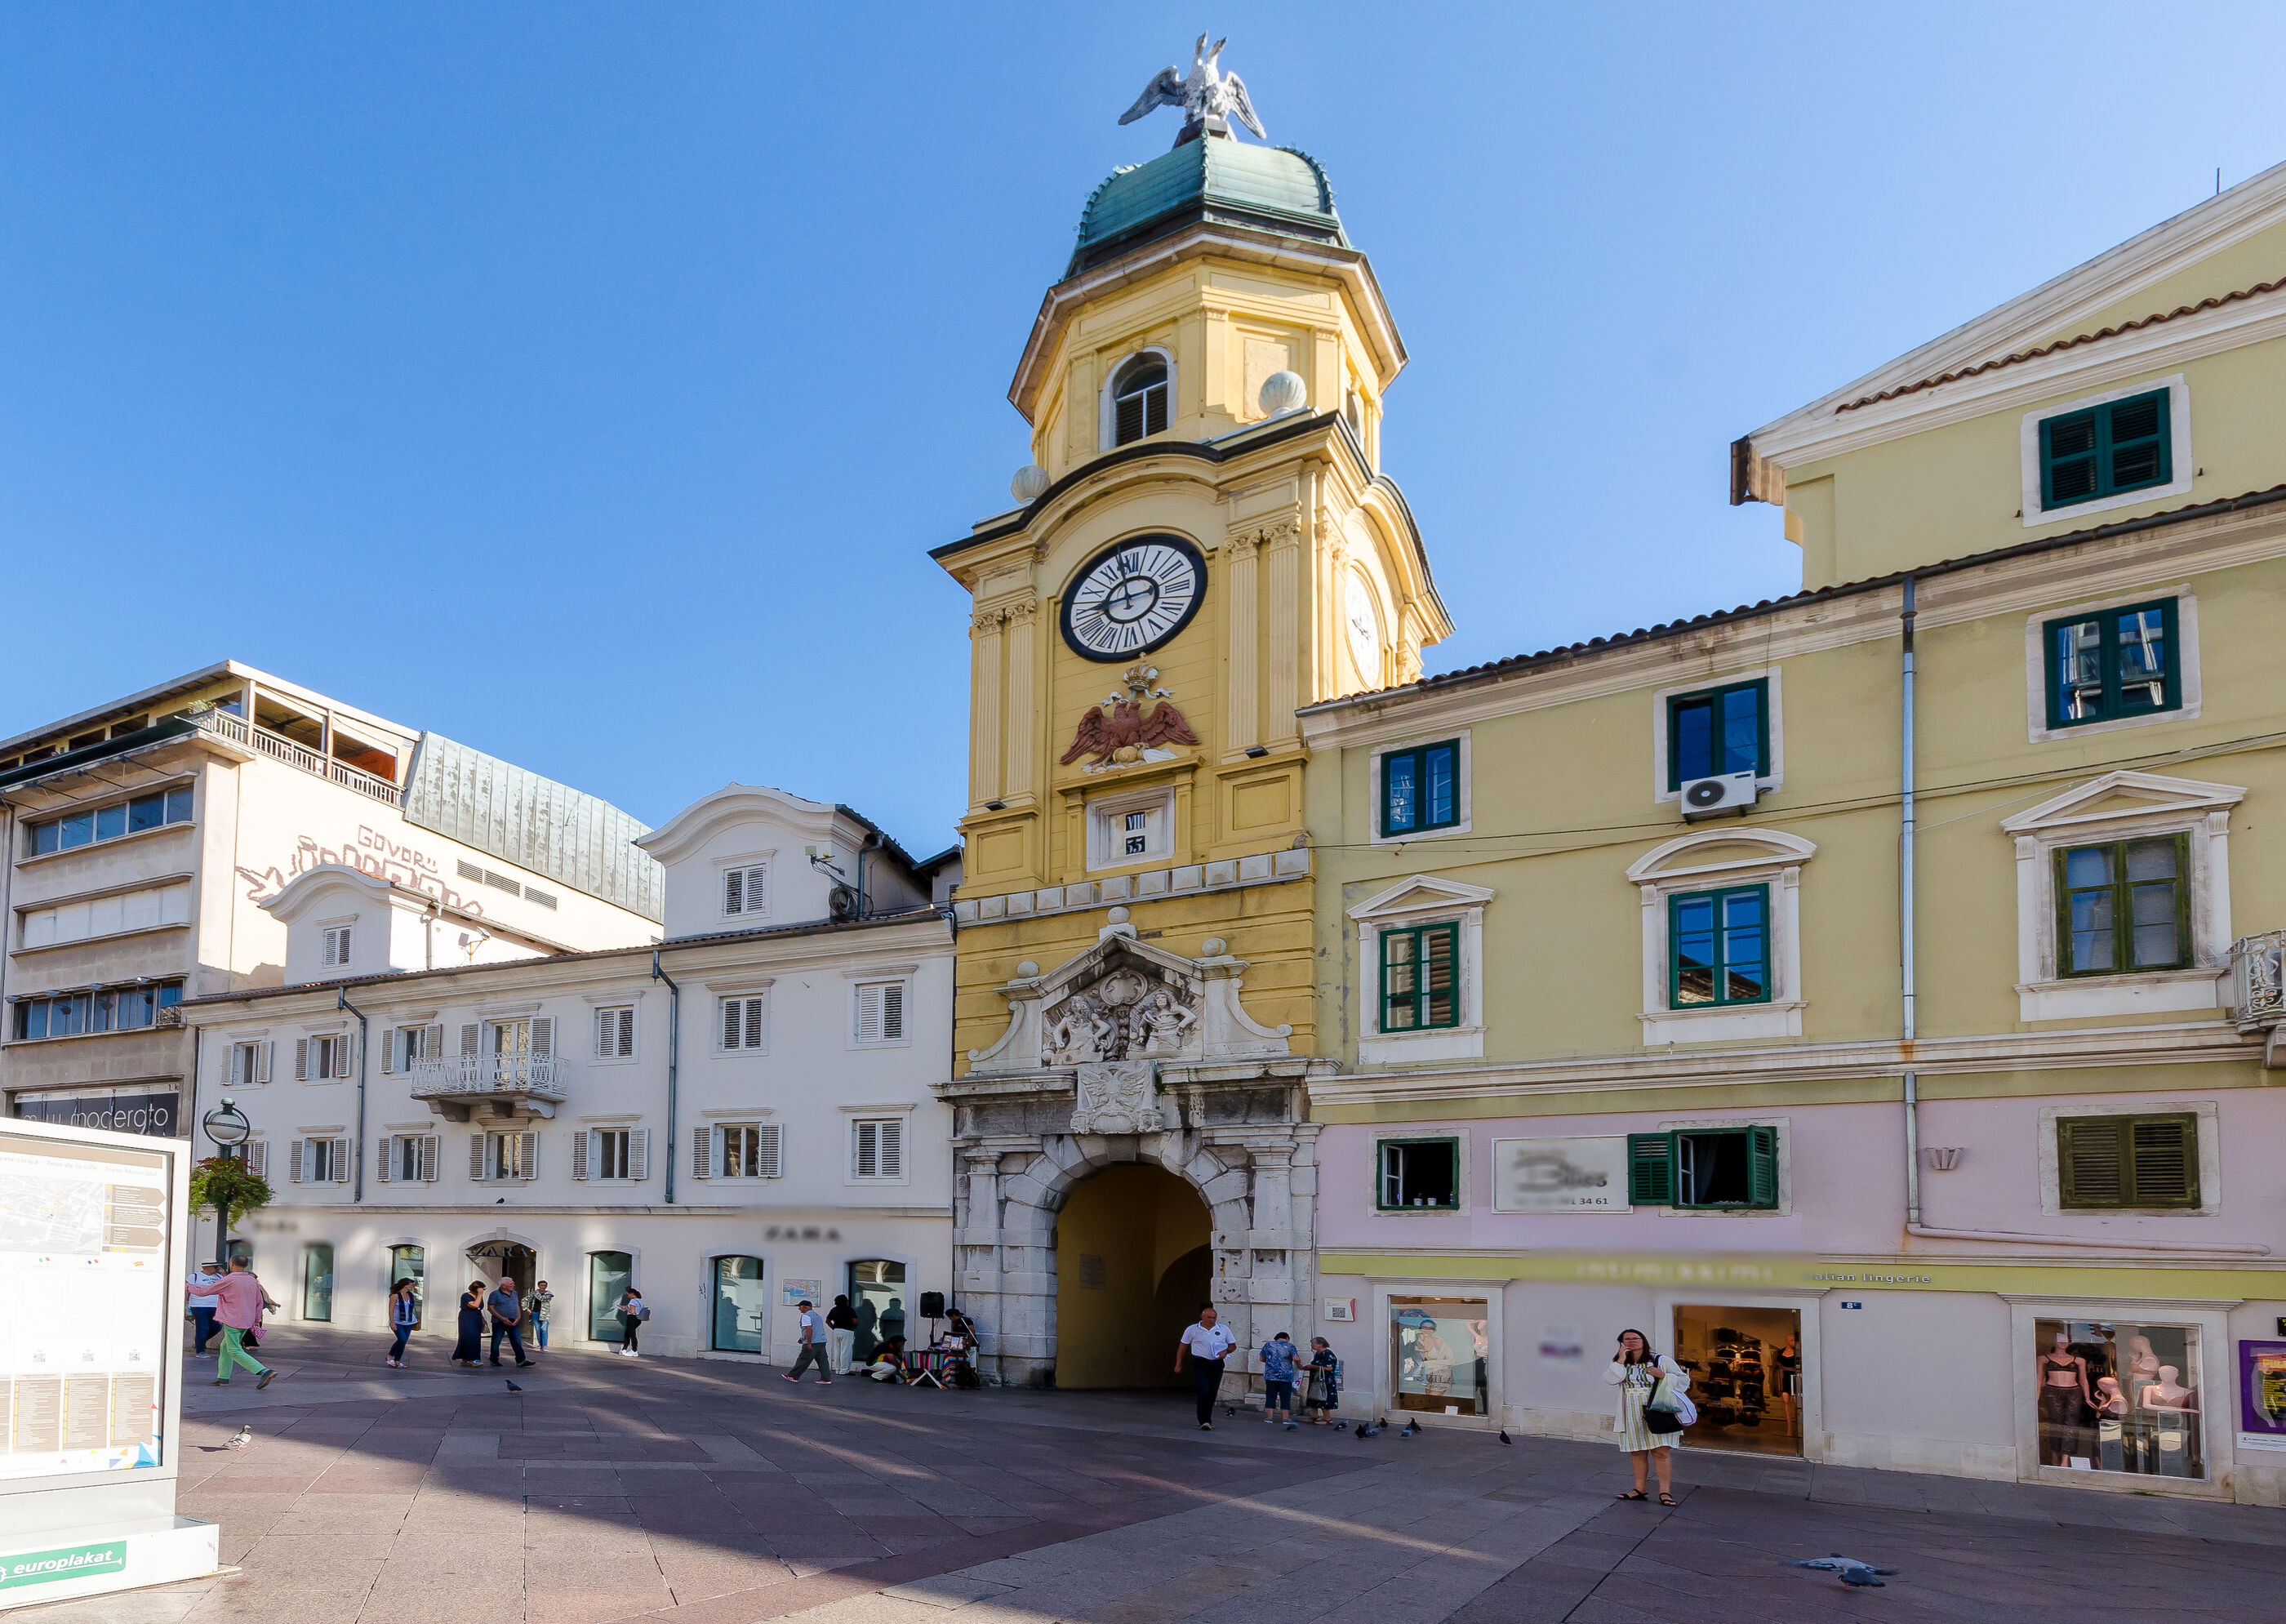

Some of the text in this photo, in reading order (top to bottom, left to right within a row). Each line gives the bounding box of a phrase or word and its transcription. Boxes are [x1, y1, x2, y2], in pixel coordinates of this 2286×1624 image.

[1127, 813, 1145, 830] VIII
[471, 1246, 529, 1257] ZARA
[1862, 1272, 1932, 1284] lingerie
[13, 1550, 113, 1571] europlakat
